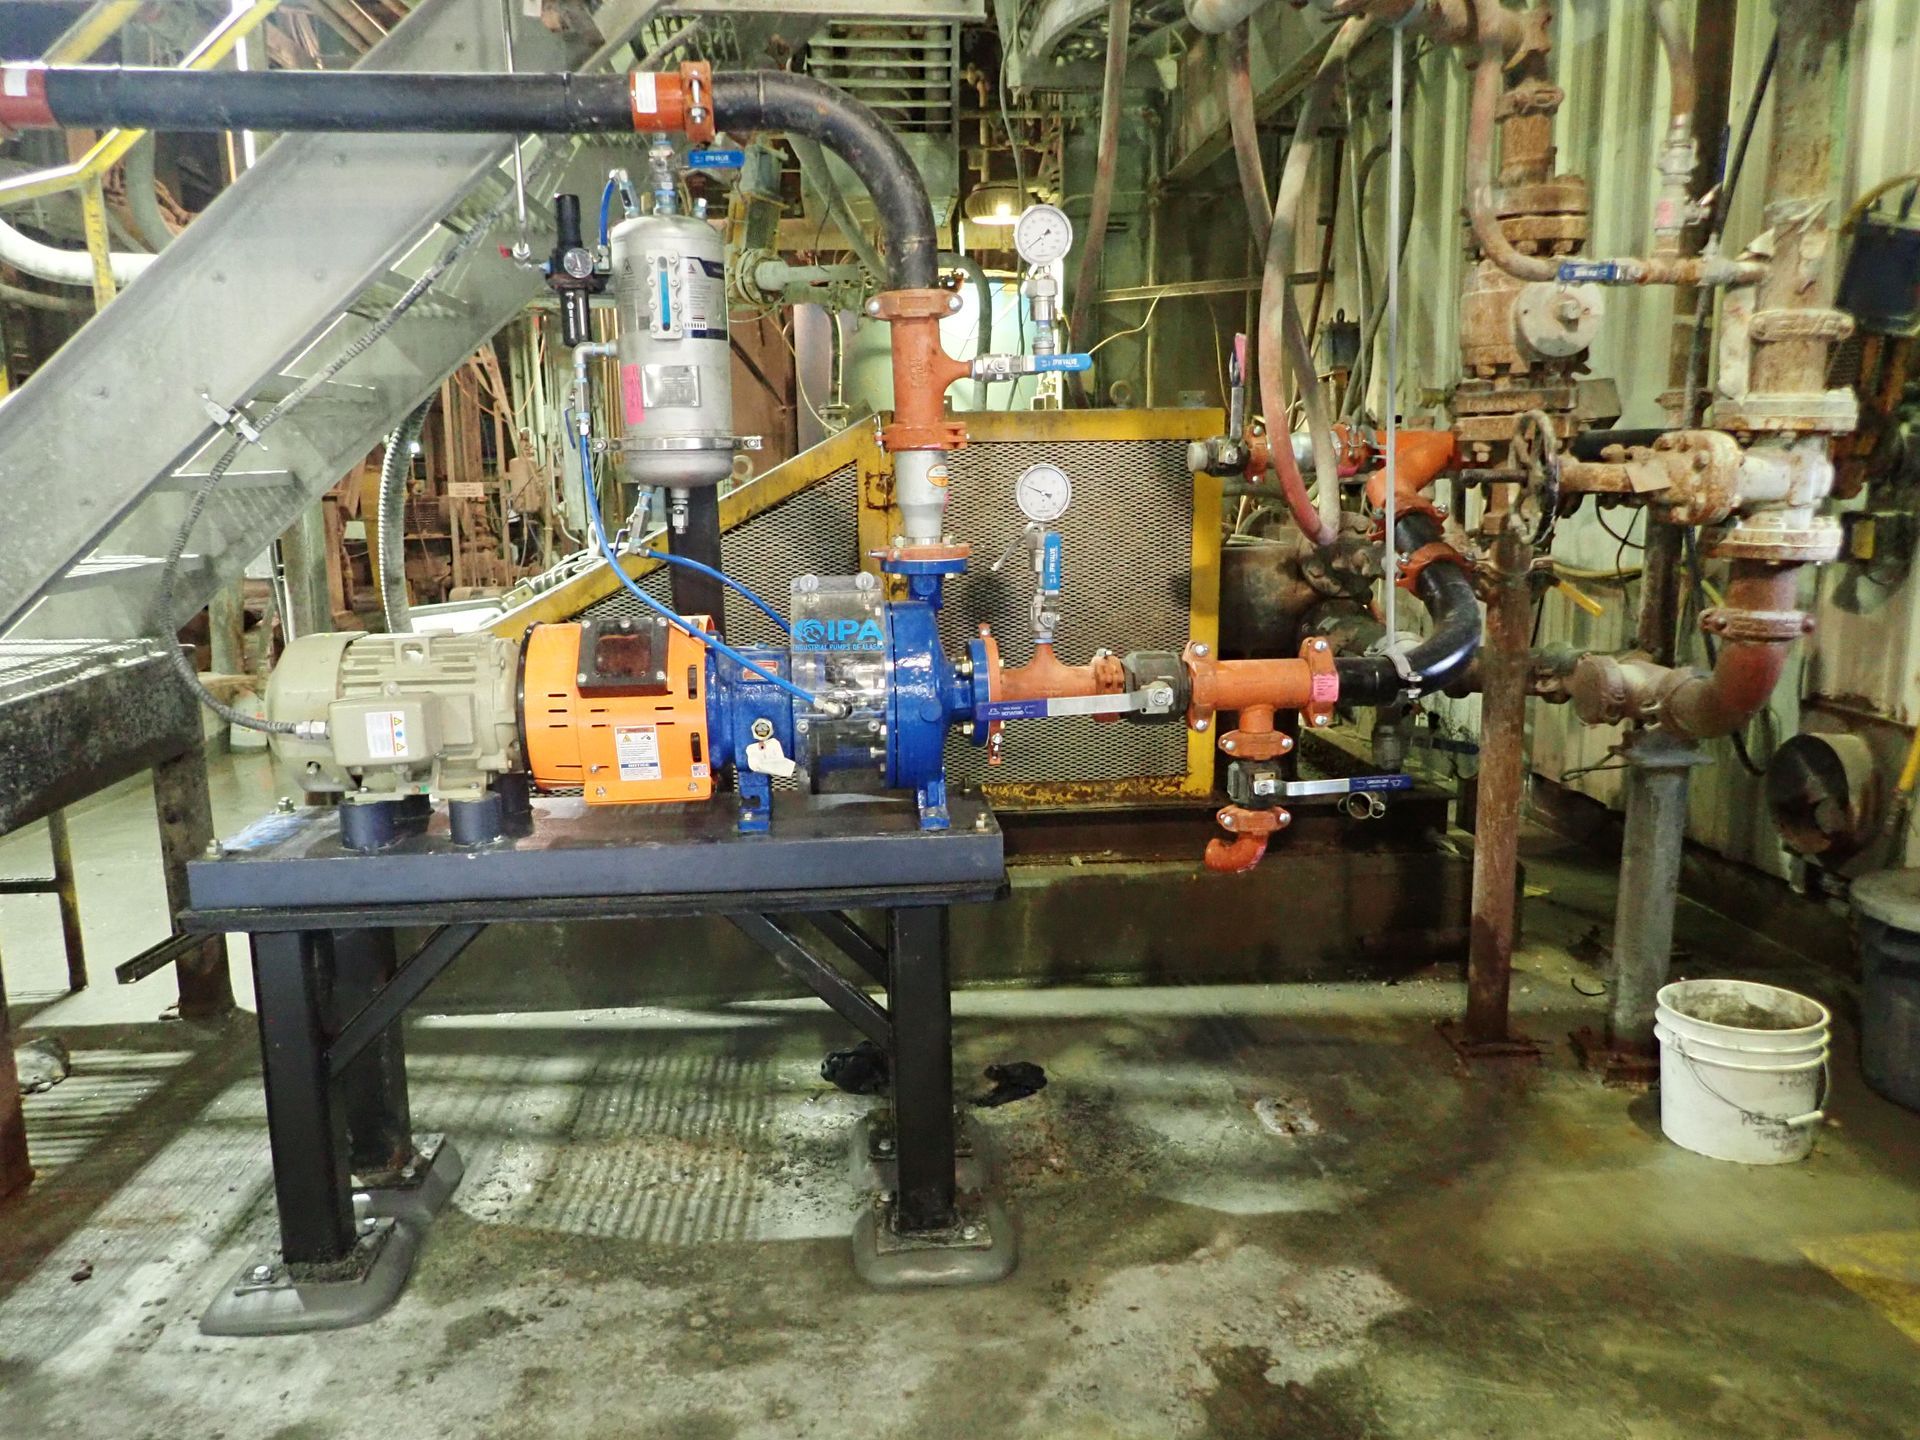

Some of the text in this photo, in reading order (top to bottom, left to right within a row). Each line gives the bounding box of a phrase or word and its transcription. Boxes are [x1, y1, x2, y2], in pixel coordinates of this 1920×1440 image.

[828, 618, 884, 641] IPA
[793, 643, 828, 651] INDUSTRIAL
[829, 643, 851, 651] PUMPS
